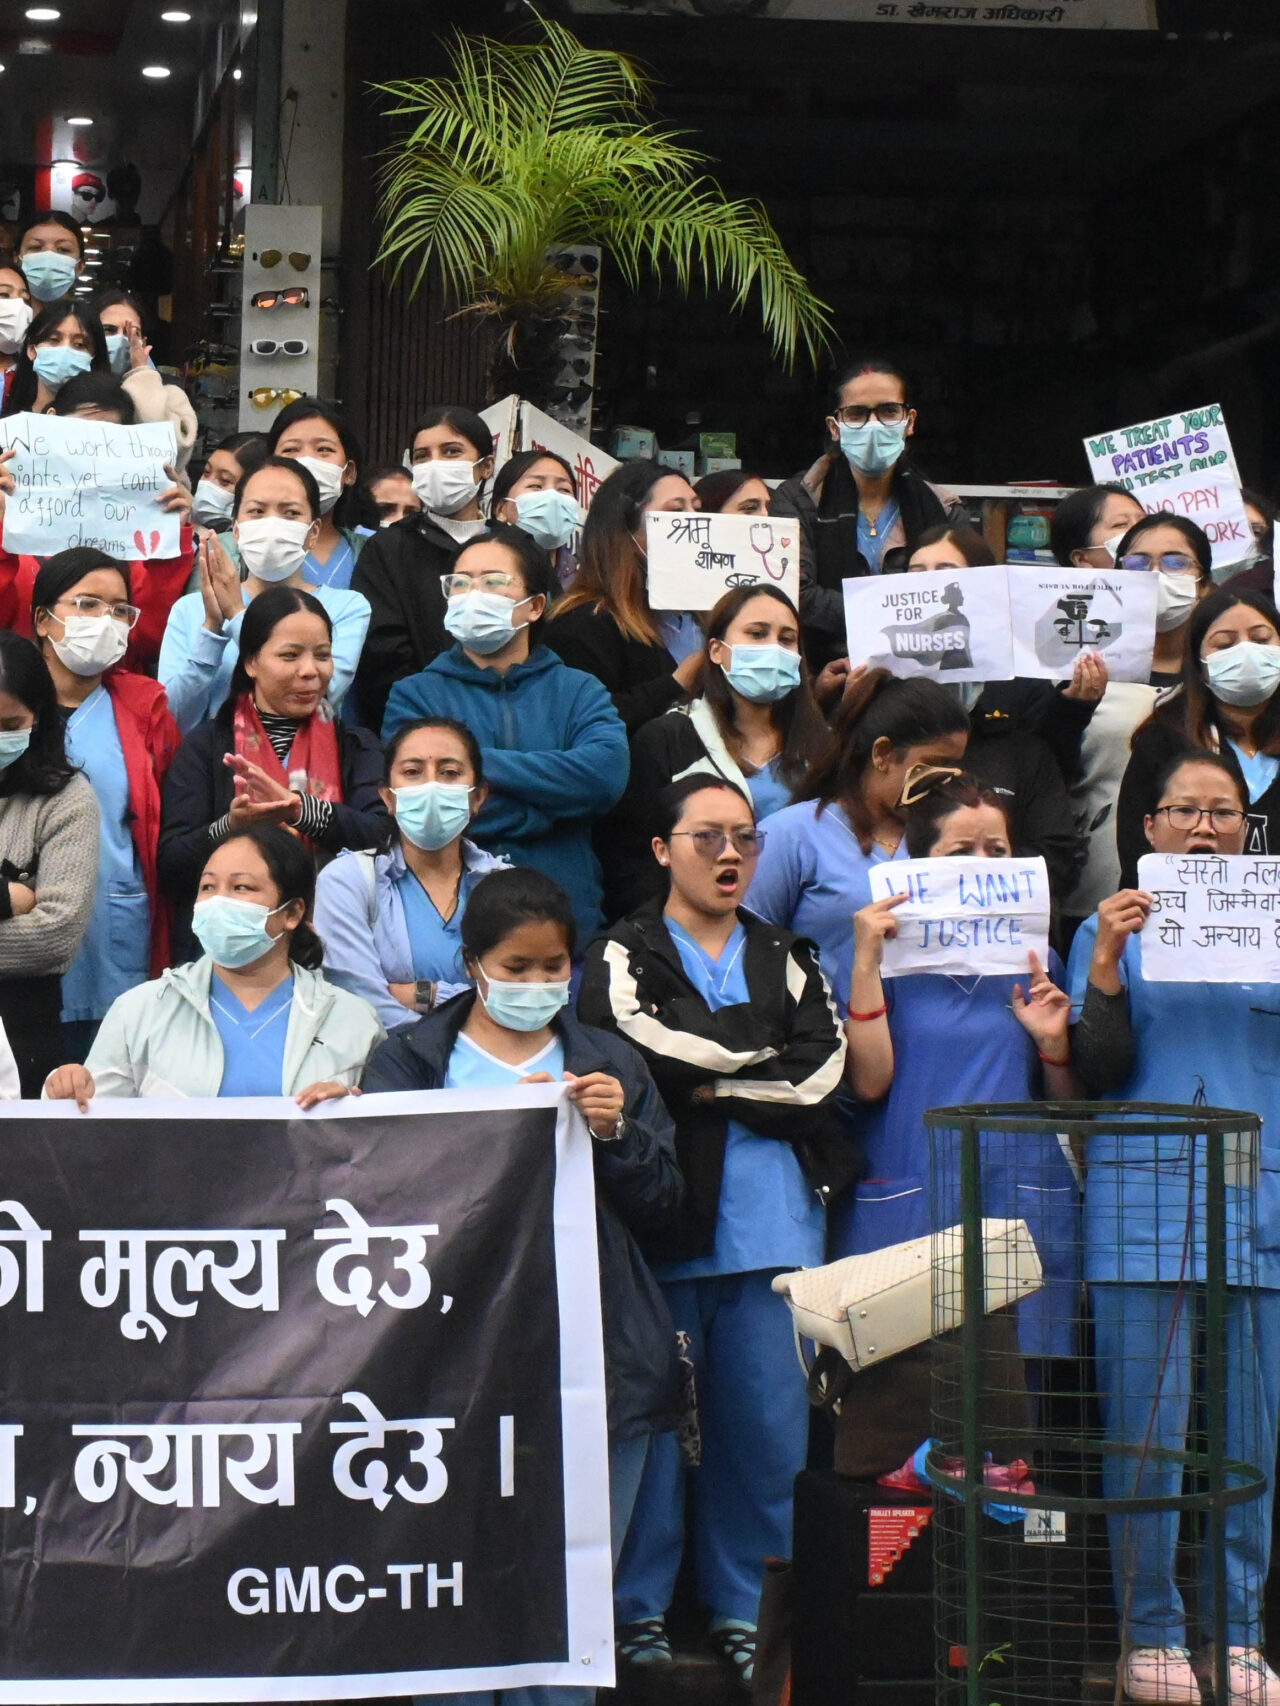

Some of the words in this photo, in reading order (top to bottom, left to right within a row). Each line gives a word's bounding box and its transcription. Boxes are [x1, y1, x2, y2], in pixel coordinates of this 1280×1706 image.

[2, 418, 50, 456] We
[65, 427, 122, 458] work
[1088, 434, 1117, 458] WE
[1120, 419, 1172, 448] TREAT
[1180, 405, 1224, 434] YOUR
[1111, 431, 1209, 476] PATIENTS
[71, 459, 104, 498] yet
[19, 490, 85, 527] afford
[104, 503, 137, 521] our
[1177, 486, 1221, 513] PAY
[1203, 520, 1246, 544] ORK
[882, 589, 939, 608] JUSTICE
[895, 607, 922, 621] FOR
[895, 630, 966, 653] NURSES
[885, 872, 934, 905] WE
[959, 870, 1036, 907] WANT
[1243, 861, 1280, 886] तल
[1207, 888, 1280, 913] जिम्मेवा
[918, 917, 1024, 949] JUSTICE
[79, 1227, 286, 1344] मूल्य
[314, 1198, 453, 1317] देउ,
[72, 1422, 302, 1509] न्याय
[329, 1391, 455, 1512] देउ
[226, 1561, 464, 1616] GMC-TH
